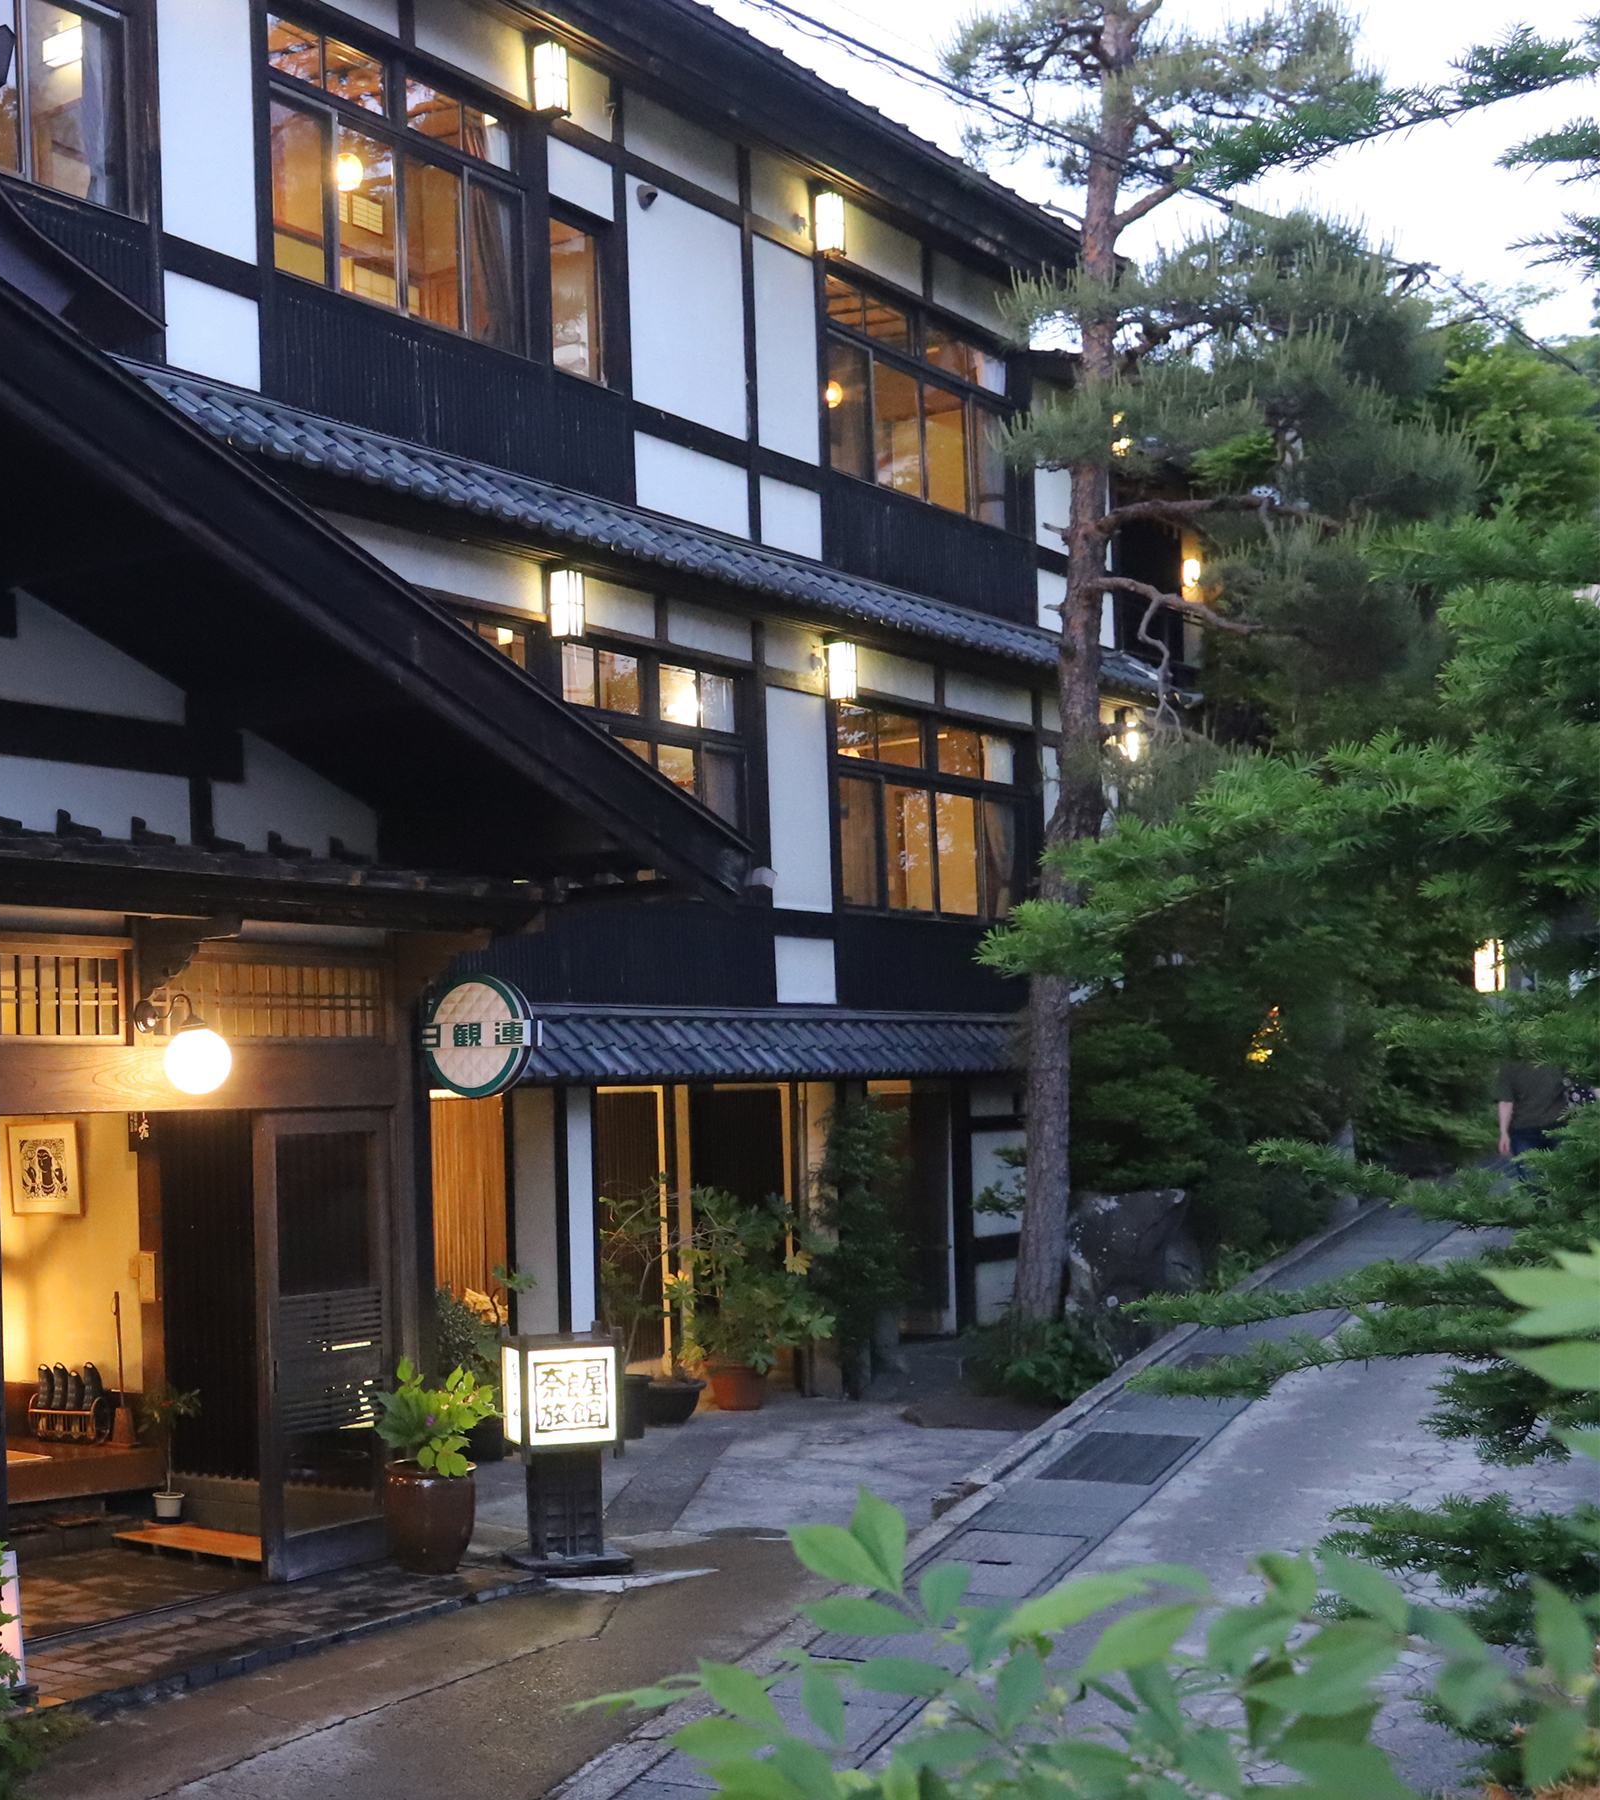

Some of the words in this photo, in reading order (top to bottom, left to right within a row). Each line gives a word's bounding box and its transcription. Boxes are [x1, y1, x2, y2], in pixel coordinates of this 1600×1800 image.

[422, 1021, 524, 1047] 日観連
[539, 1366, 602, 1399] 奈良屋
[541, 1399, 602, 1427] 旅館
